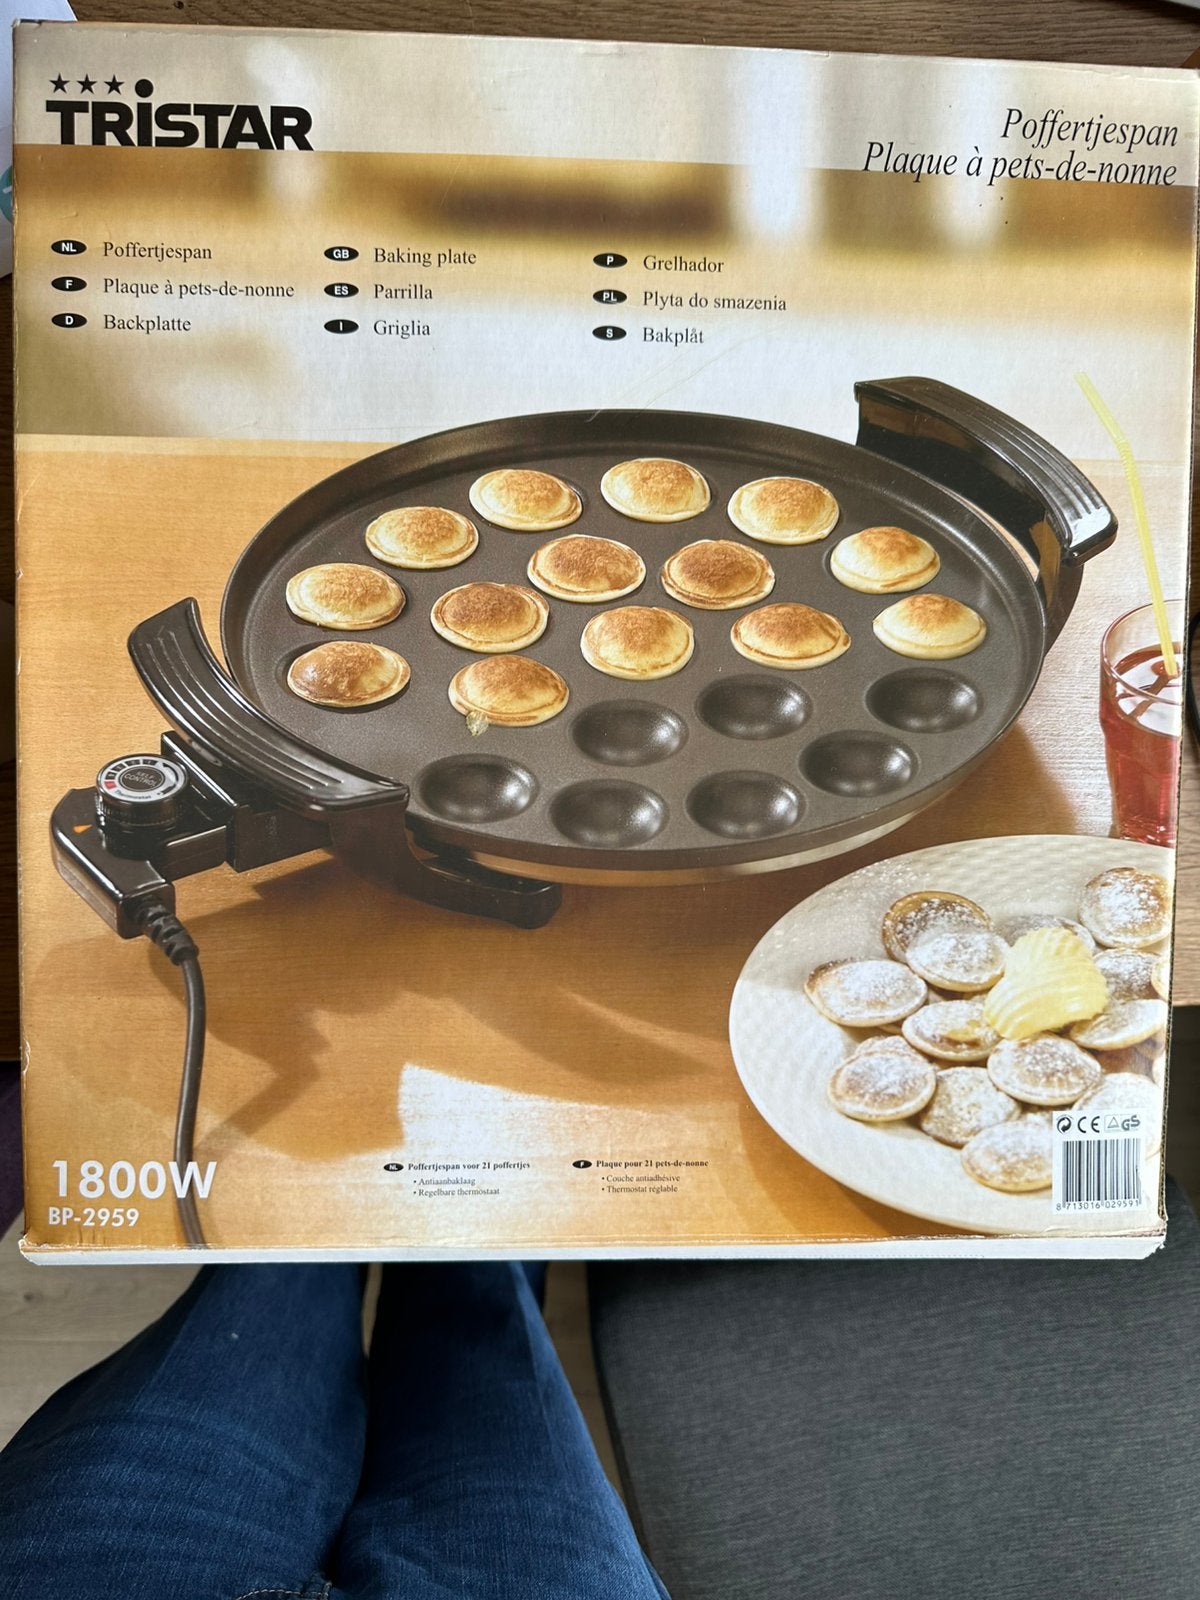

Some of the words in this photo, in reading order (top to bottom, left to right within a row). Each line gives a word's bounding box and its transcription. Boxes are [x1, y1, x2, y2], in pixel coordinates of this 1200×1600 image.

[1000, 107, 1178, 154] Poffertjespan
[862, 141, 958, 183] Plaque
[966, 146, 982, 177] à
[987, 150, 1177, 187] pets-de-nonne
[61, 243, 77, 253] NL
[103, 242, 212, 262] Poffertjespan
[332, 249, 350, 259] GB
[374, 247, 432, 267] Baking
[437, 249, 477, 267] plate
[606, 256, 614, 265] P
[643, 255, 725, 273] Grelhador
[65, 280, 73, 289] F
[103, 278, 160, 298] Plaque
[165, 279, 174, 295] à
[179, 281, 296, 299] pets-de-nonne
[334, 286, 349, 296] ES
[374, 284, 433, 300] Parrilla
[602, 292, 618, 302] PL
[643, 291, 683, 311] Plyta
[689, 292, 709, 308] do
[714, 296, 787, 311] smazenia
[65, 315, 74, 325] D
[103, 314, 192, 334] Backplatte
[373, 319, 430, 339] Griglia
[606, 328, 613, 338] S
[642, 327, 704, 347] Bakplåt
[408, 1162, 460, 1172] Poffertjespan
[482, 1162, 491, 1170] 21
[493, 1161, 530, 1171] poffertjes
[596, 1160, 622, 1168] Plaque
[624, 1161, 642, 1169] pour
[655, 1160, 709, 1169] pets-de-nonne
[52, 1160, 218, 1199] 1800W
[418, 1177, 476, 1187] Antiaanbaklaag
[606, 1174, 634, 1182] Couche
[635, 1174, 681, 1182] antiadhésive
[418, 1188, 455, 1198] Regelbare
[457, 1188, 500, 1196] thermostaat
[606, 1185, 647, 1193] Thermostat
[48, 1206, 139, 1227] BP-2959
